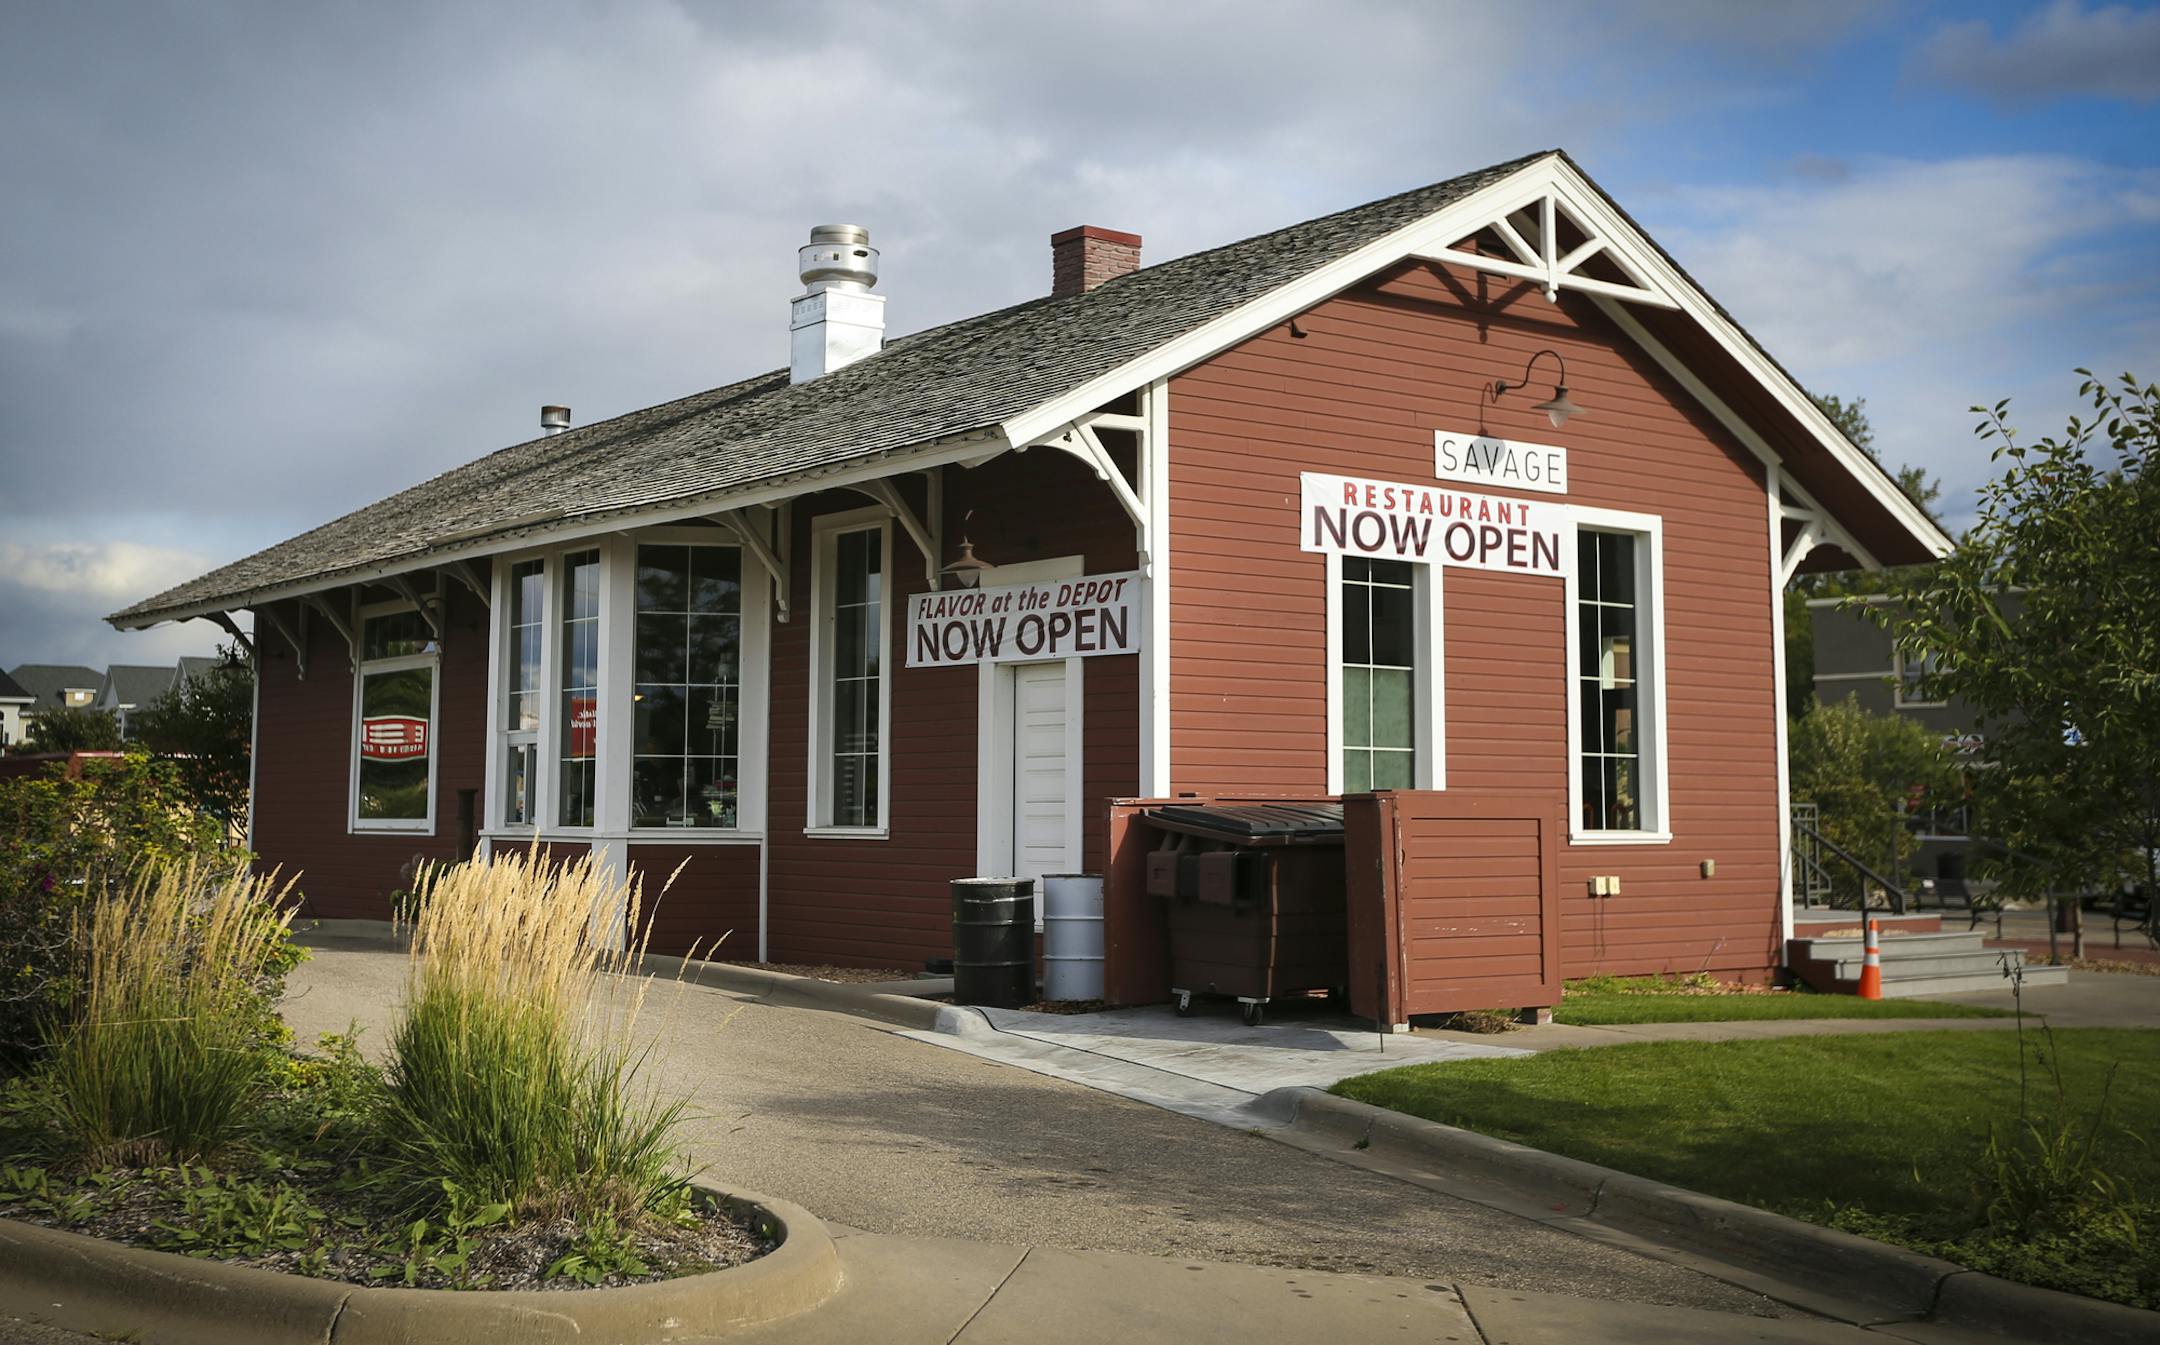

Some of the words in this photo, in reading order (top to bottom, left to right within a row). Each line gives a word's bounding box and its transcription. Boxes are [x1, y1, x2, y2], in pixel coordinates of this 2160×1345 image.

[1442, 440, 1561, 485] SAVAGE
[1343, 482, 1530, 526] RESTAURANT
[1313, 505, 1433, 557] NOW
[1444, 521, 1559, 571] OPEN
[918, 593, 987, 620] FLAVOR
[991, 592, 1012, 613] at
[1017, 587, 1050, 611] the
[1056, 578, 1128, 607] DEPOT
[917, 617, 1007, 663] NOW
[1015, 606, 1128, 656] OPEN
